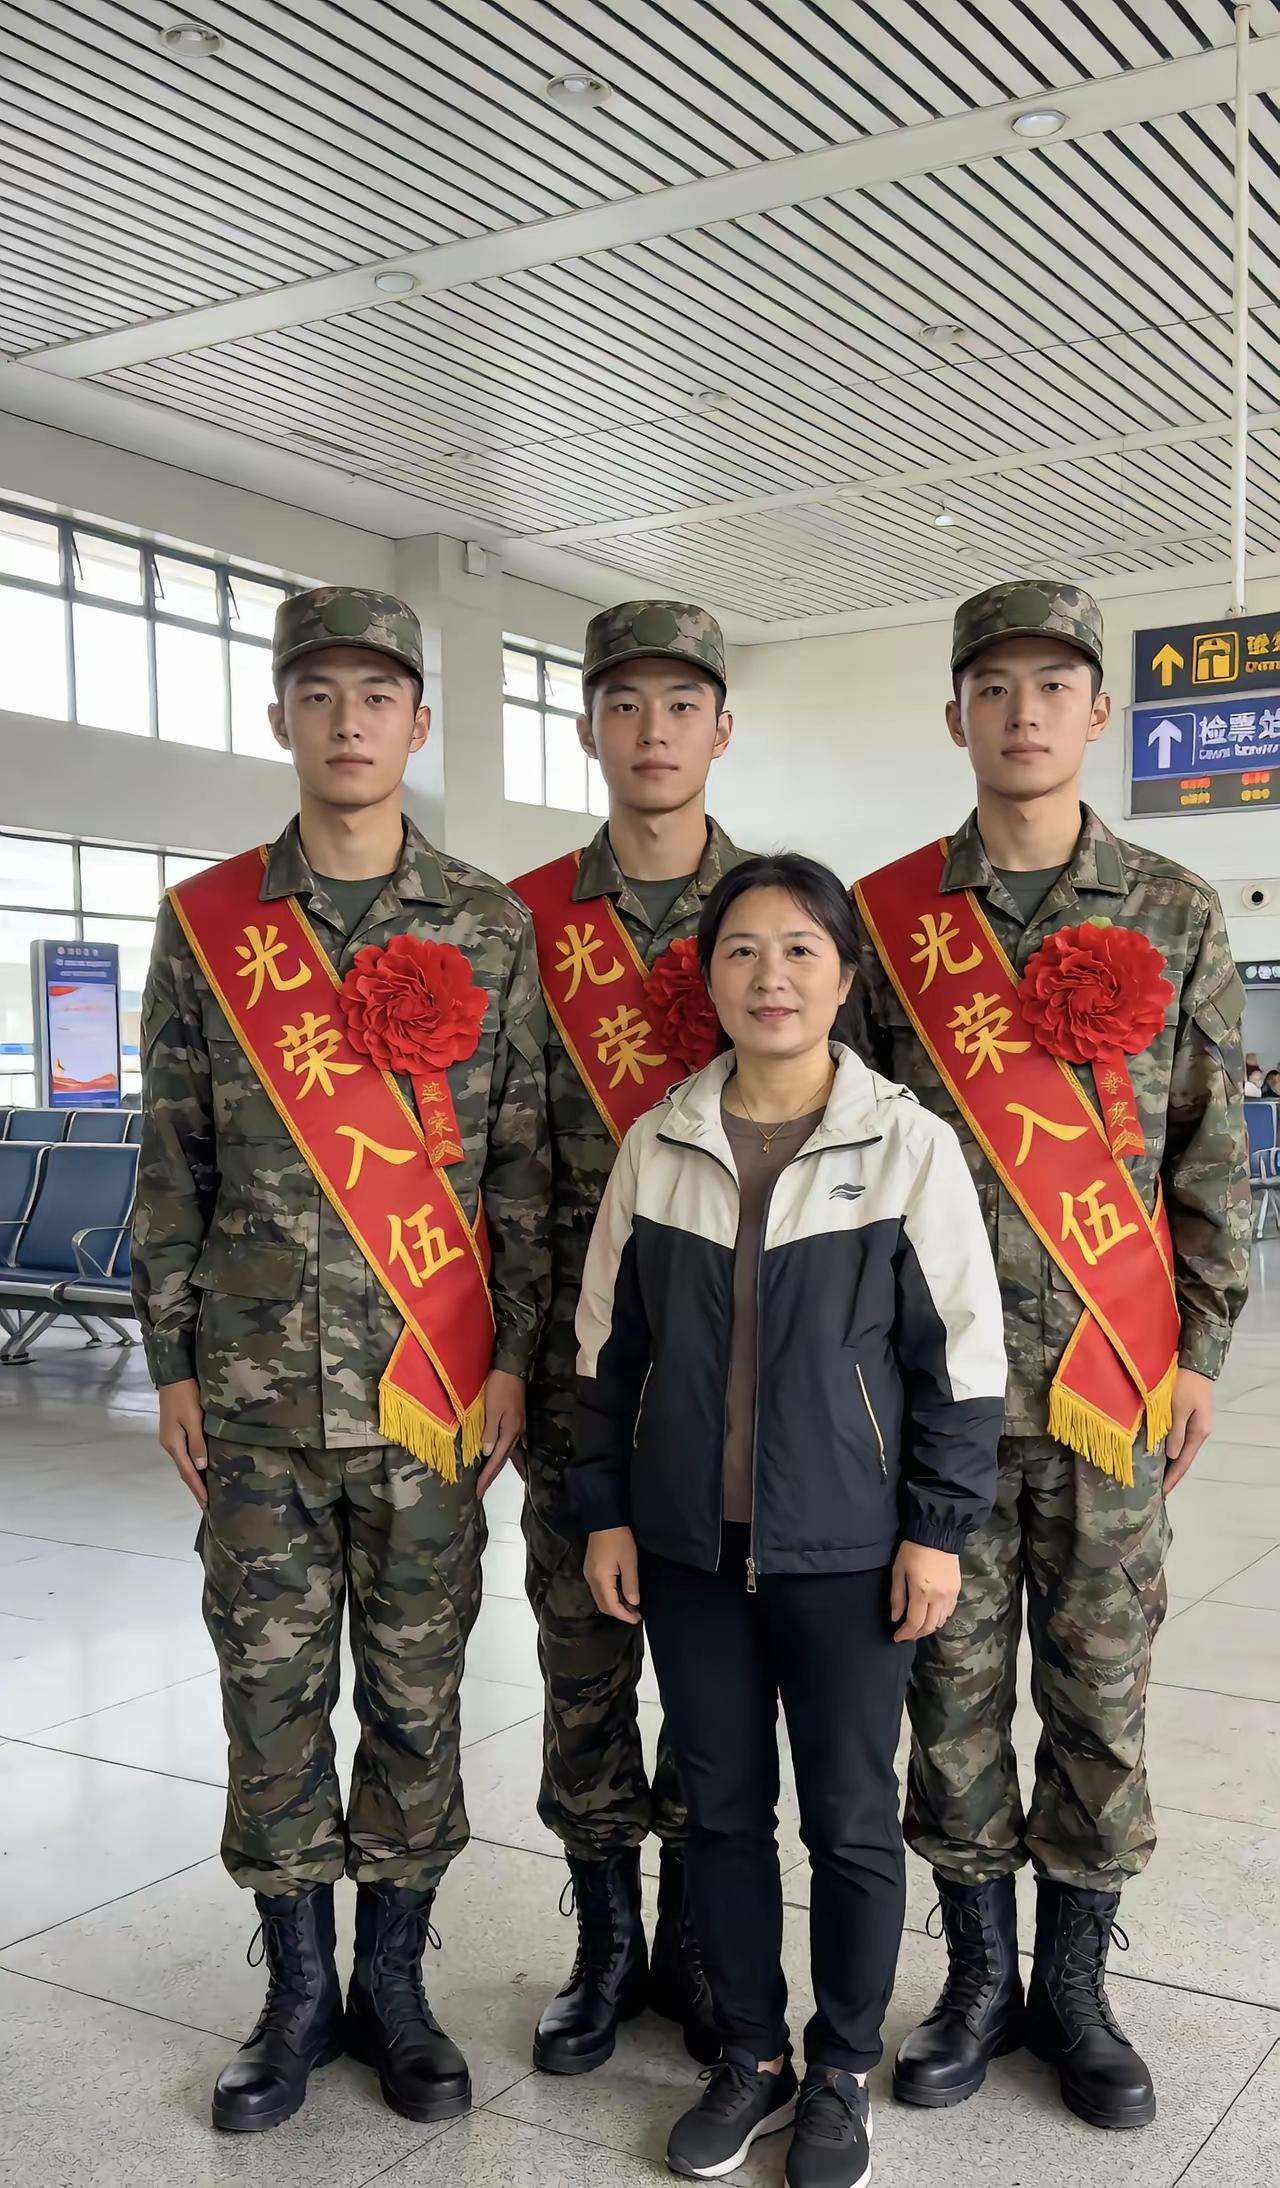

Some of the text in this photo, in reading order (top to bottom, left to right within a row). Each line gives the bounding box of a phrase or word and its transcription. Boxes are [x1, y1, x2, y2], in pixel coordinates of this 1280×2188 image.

[235, 925, 465, 1288] 光荣入伍
[554, 923, 668, 1089] 光荣
[909, 911, 1139, 1265] 光荣入伍
